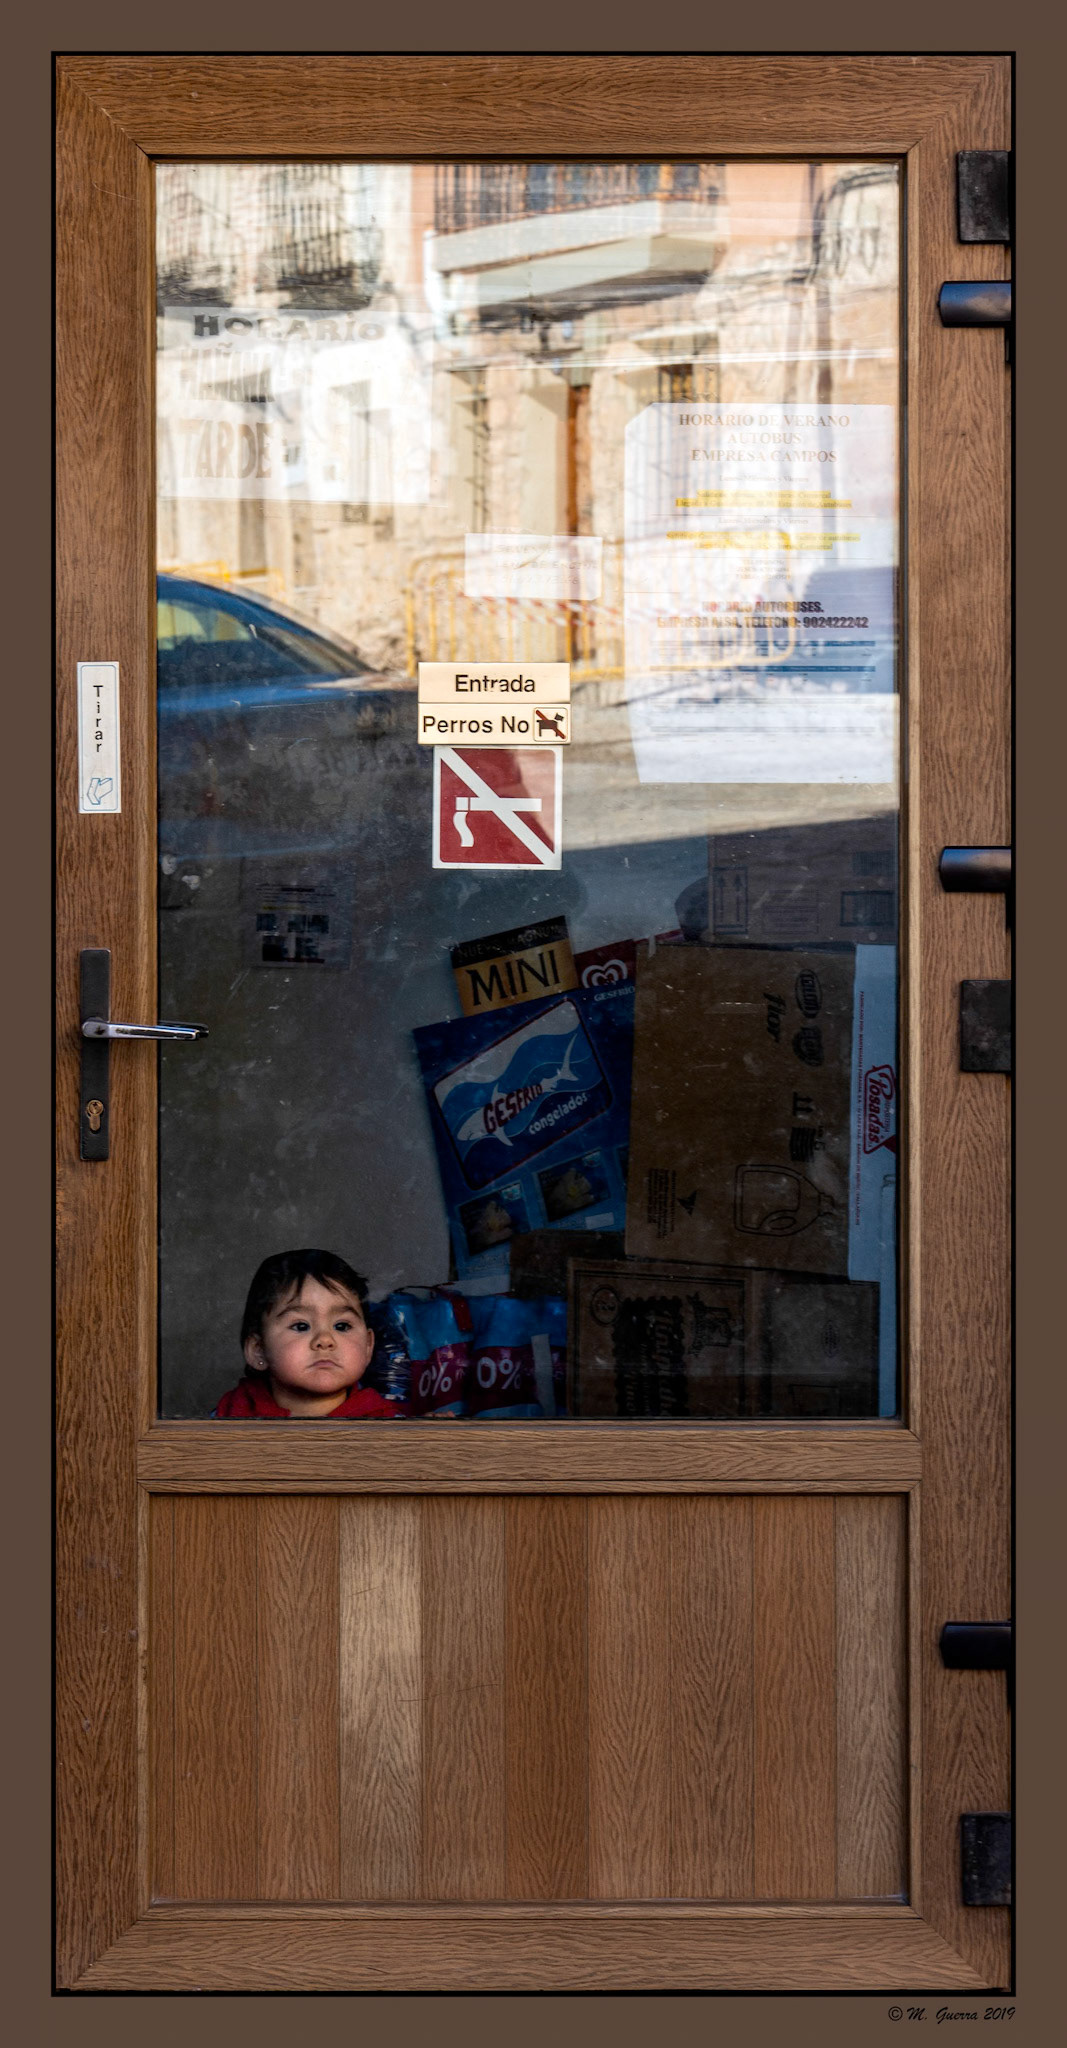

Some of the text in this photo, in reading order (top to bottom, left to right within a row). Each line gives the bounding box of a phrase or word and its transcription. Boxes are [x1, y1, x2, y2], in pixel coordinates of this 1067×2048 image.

[193, 311, 386, 342] HORARIO
[679, 414, 850, 428] HORARIO DE VERANO
[178, 418, 273, 480] TARDE
[727, 432, 802, 445] AUTOBUS
[691, 449, 838, 463] EMPRESA CAMPOS
[803, 616, 869, 629] 902422242
[455, 674, 536, 693] Entrada
[92, 685, 104, 753] Tirar
[423, 716, 530, 733] Perros No
[466, 950, 561, 1006] MINI
[483, 1083, 543, 1135] GESFRIO
[528, 1092, 589, 1136] congelados
[868, 1072, 894, 1144] Posadas
[419, 1361, 453, 1397] 0%
